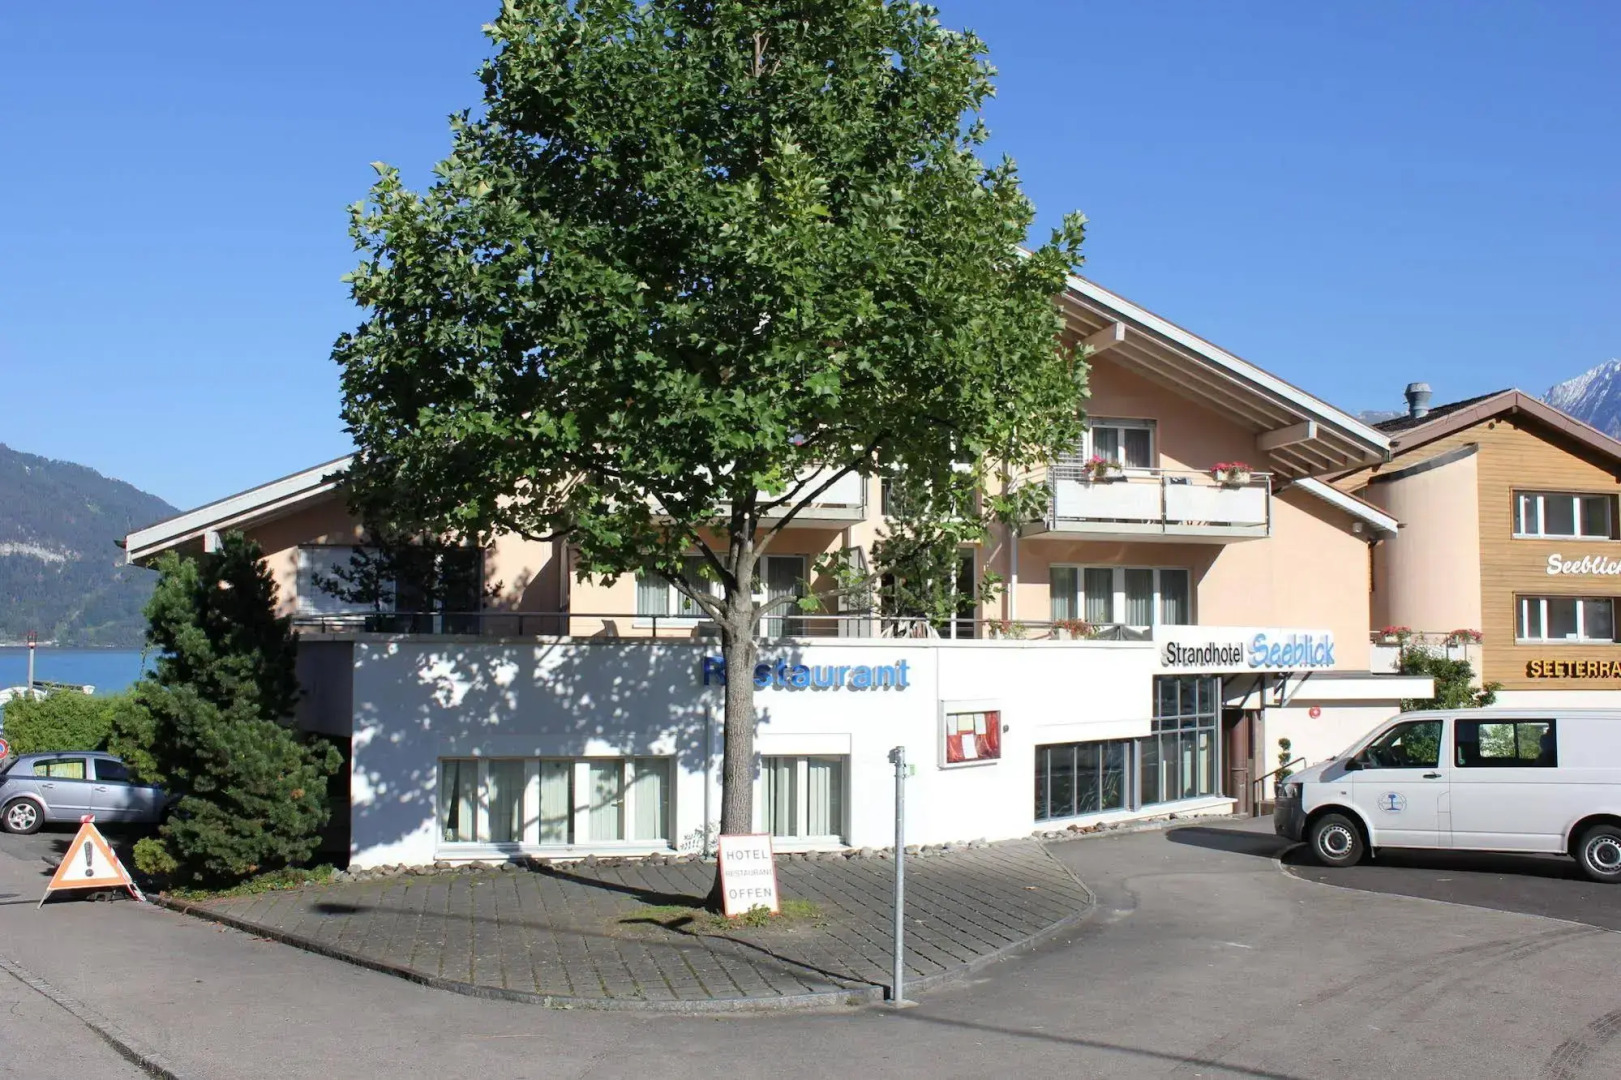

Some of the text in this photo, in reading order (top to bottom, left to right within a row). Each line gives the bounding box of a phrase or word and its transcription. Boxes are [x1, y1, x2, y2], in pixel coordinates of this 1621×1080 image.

[1166, 633, 1335, 666] Strandhotel Seeblick
[703, 656, 911, 687] Rstaurant
[726, 849, 769, 861] HOTEL
[728, 887, 772, 900] OFFEN
